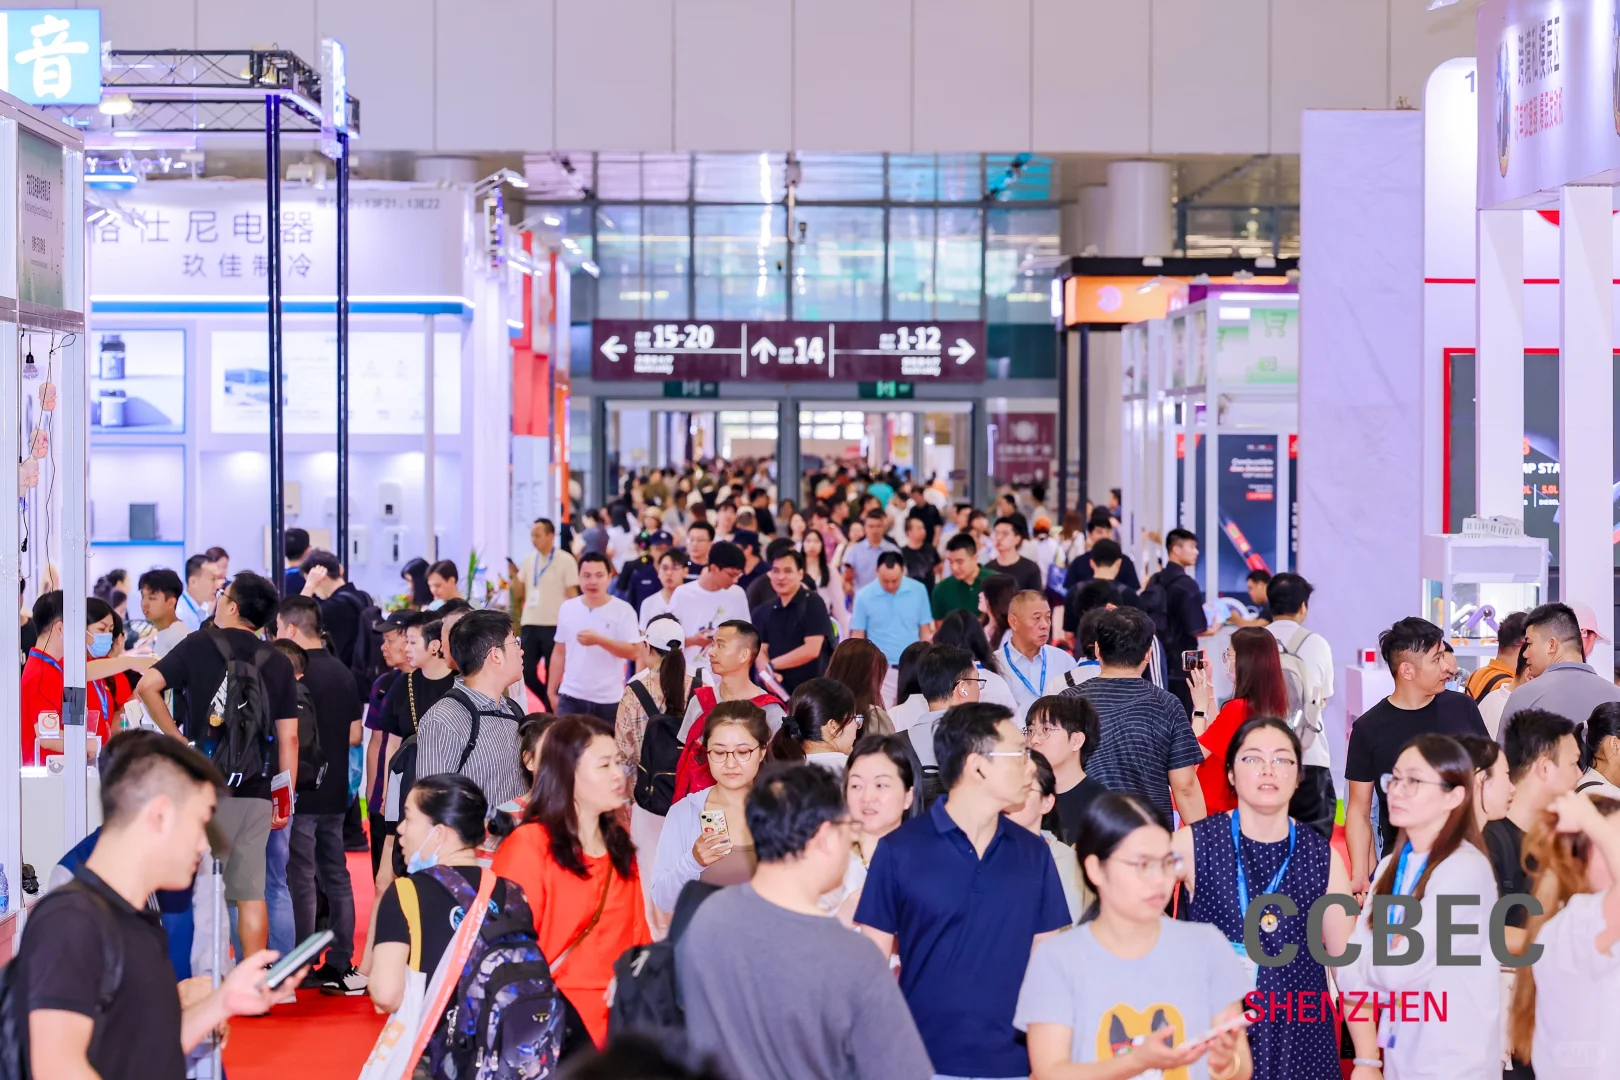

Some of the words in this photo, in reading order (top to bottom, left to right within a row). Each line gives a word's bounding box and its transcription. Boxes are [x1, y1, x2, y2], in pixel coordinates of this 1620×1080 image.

[14, 14, 90, 100] 音
[182, 253, 313, 279] 玖佳制冷
[653, 324, 715, 350] 15-20
[897, 326, 942, 351] 1-12
[794, 336, 825, 365] 14
